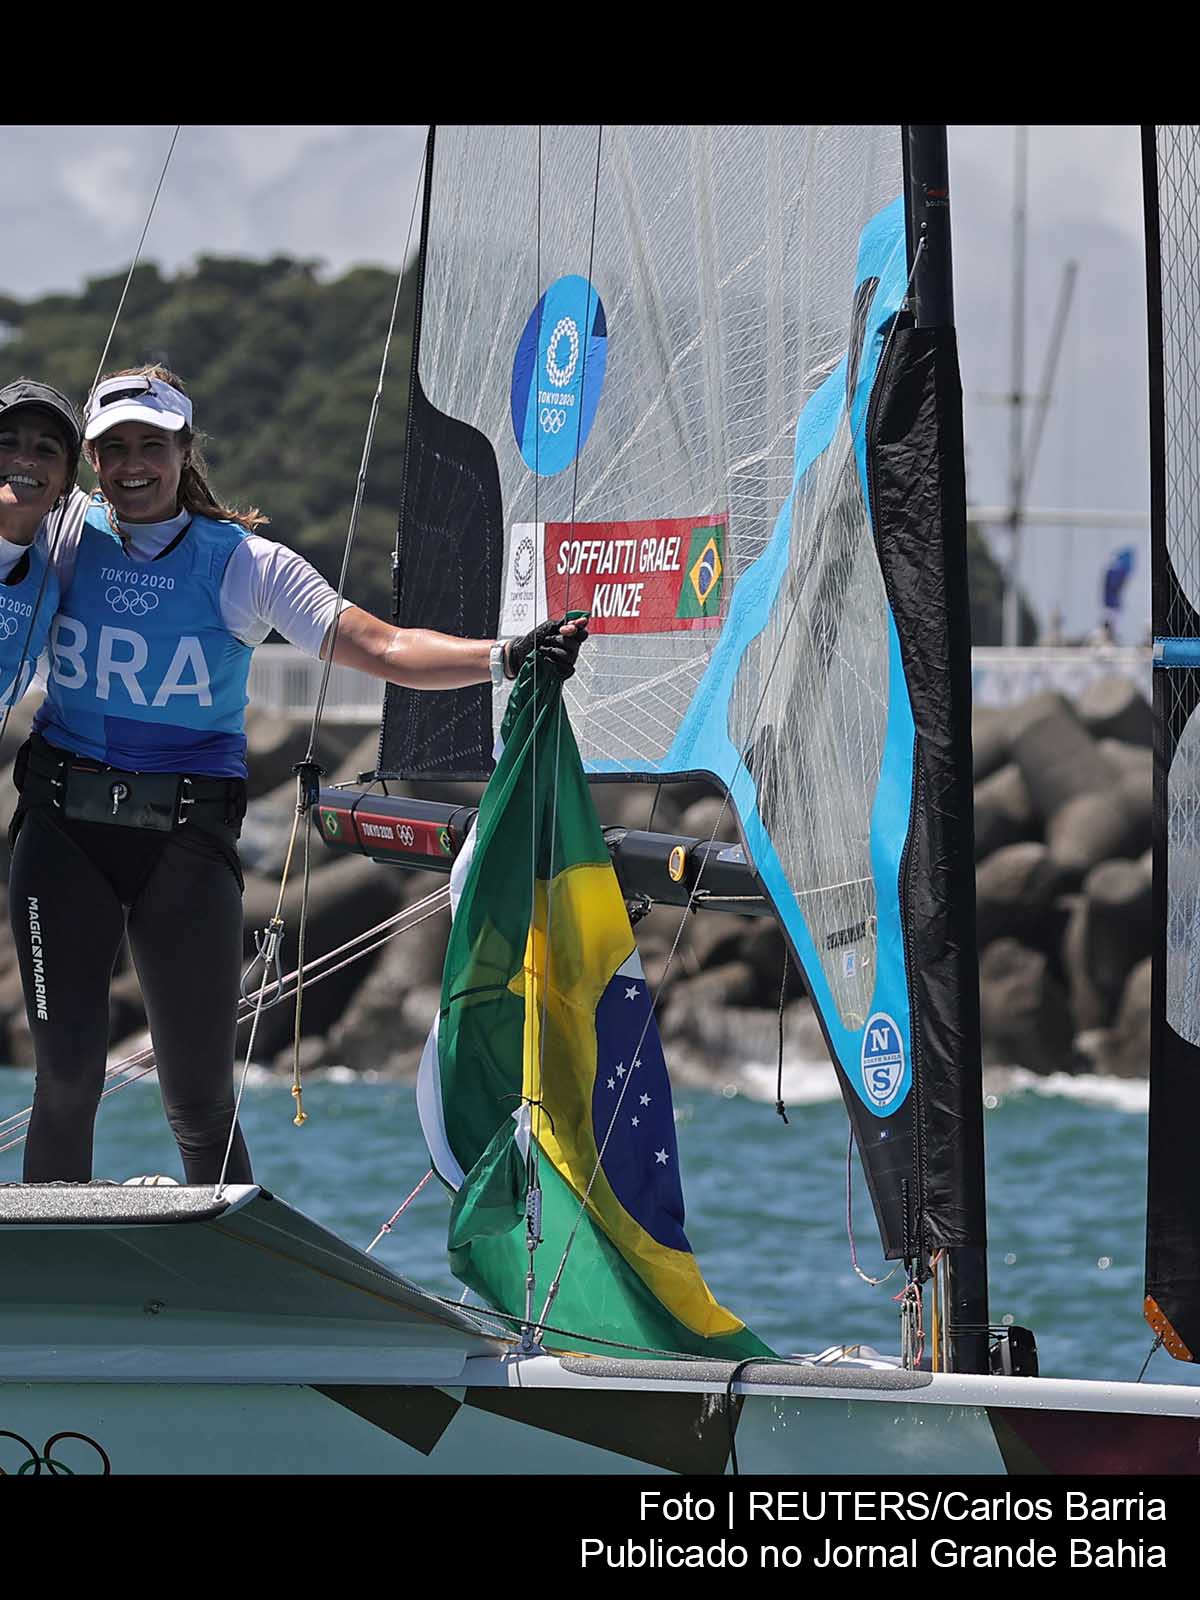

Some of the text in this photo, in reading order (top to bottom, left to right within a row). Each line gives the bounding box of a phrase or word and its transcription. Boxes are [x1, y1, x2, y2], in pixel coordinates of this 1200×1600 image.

[538, 391, 560, 405] TOKYO
[556, 536, 681, 575] SOFFIATTI GRAEL
[100, 567, 175, 590] TOKYO 2020
[8, 600, 33, 618] 2020
[591, 583, 644, 618] KUNZE
[51, 614, 213, 707] BRA
[361, 822, 394, 839] TOKYO 2020
[27, 896, 49, 1021] MAGIC MARINE
[870, 1027, 890, 1052] N
[873, 1068, 891, 1092] S
